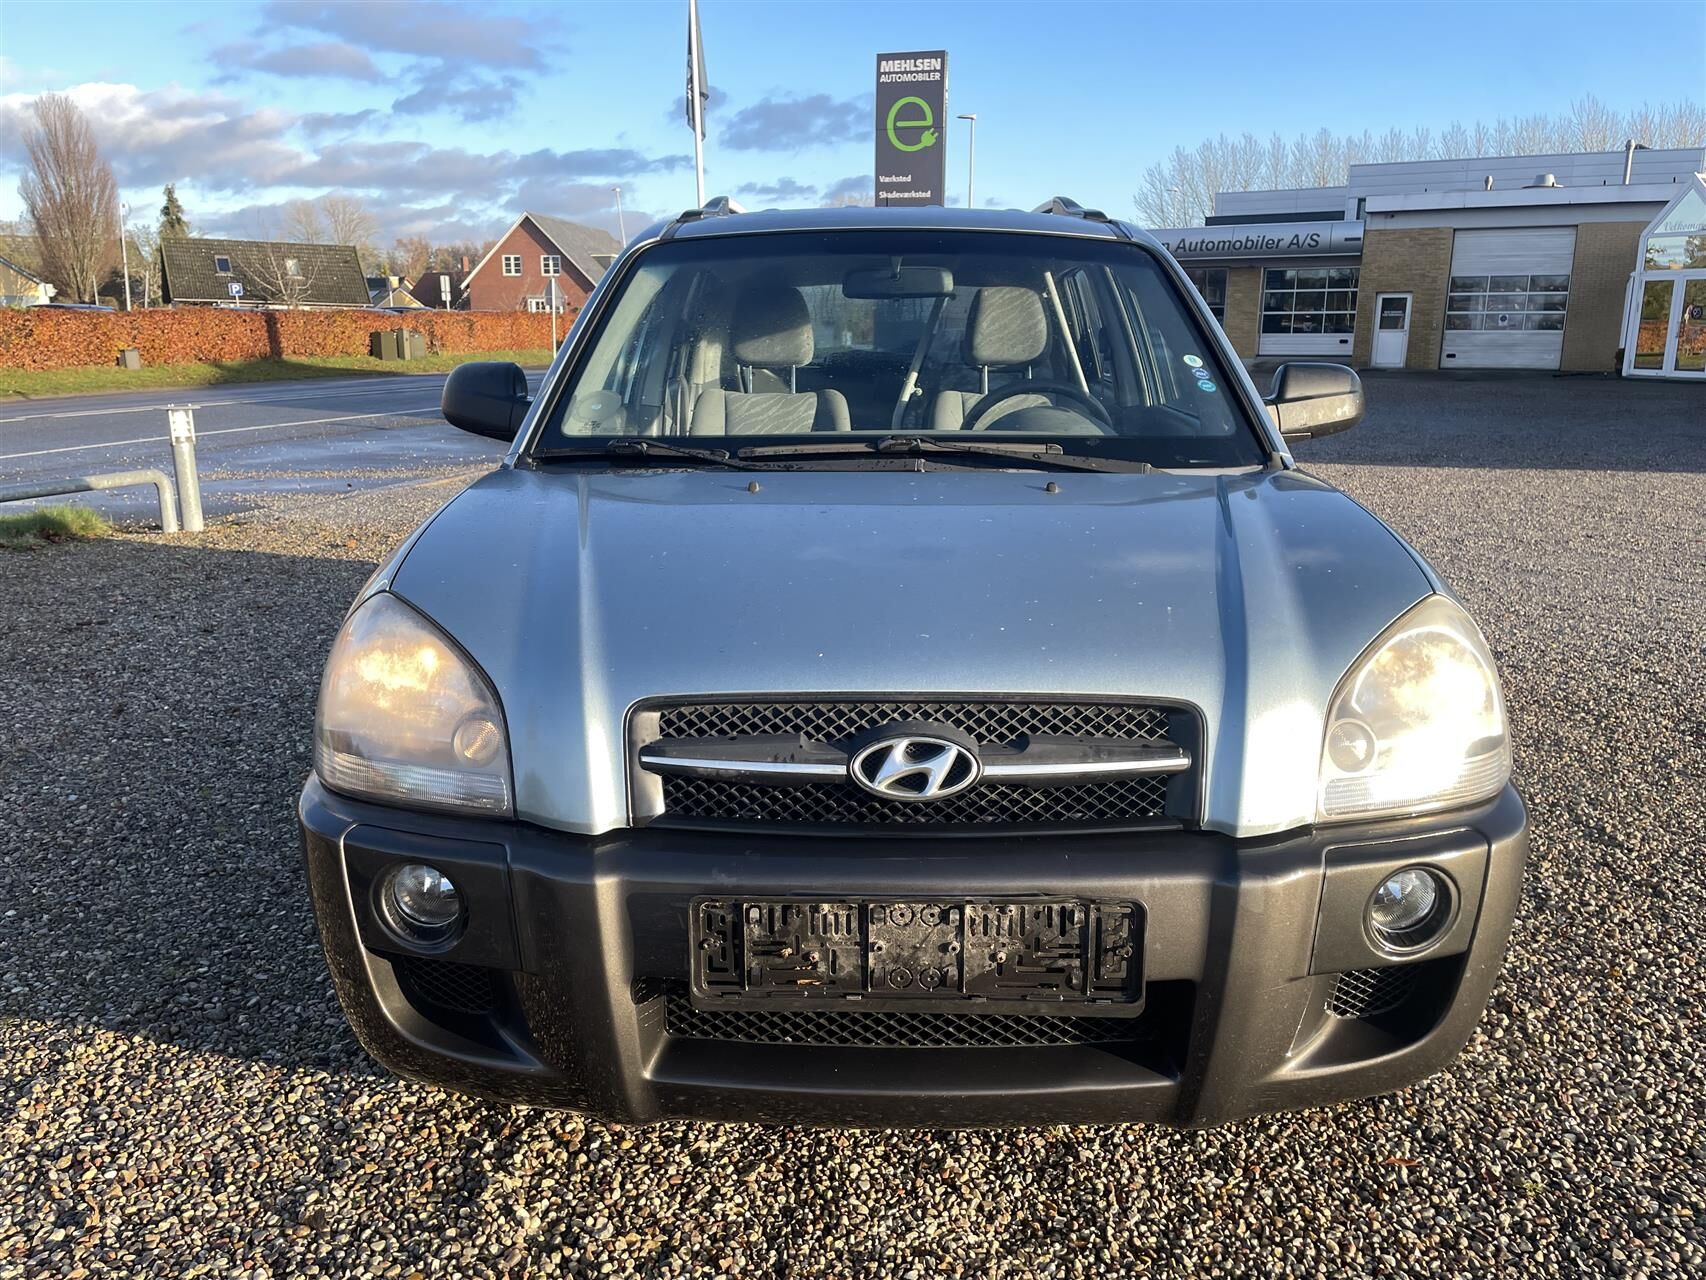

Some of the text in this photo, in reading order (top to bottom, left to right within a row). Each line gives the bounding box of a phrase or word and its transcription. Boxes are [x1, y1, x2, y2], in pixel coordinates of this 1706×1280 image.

[880, 58, 941, 72] MEHLSEN
[879, 72, 941, 82] AUTOMOBILER
[879, 174, 912, 182] Værksted
[1175, 234, 1284, 252] Automobiler
[1287, 233, 1321, 249] A/S
[231, 284, 241, 295] P
